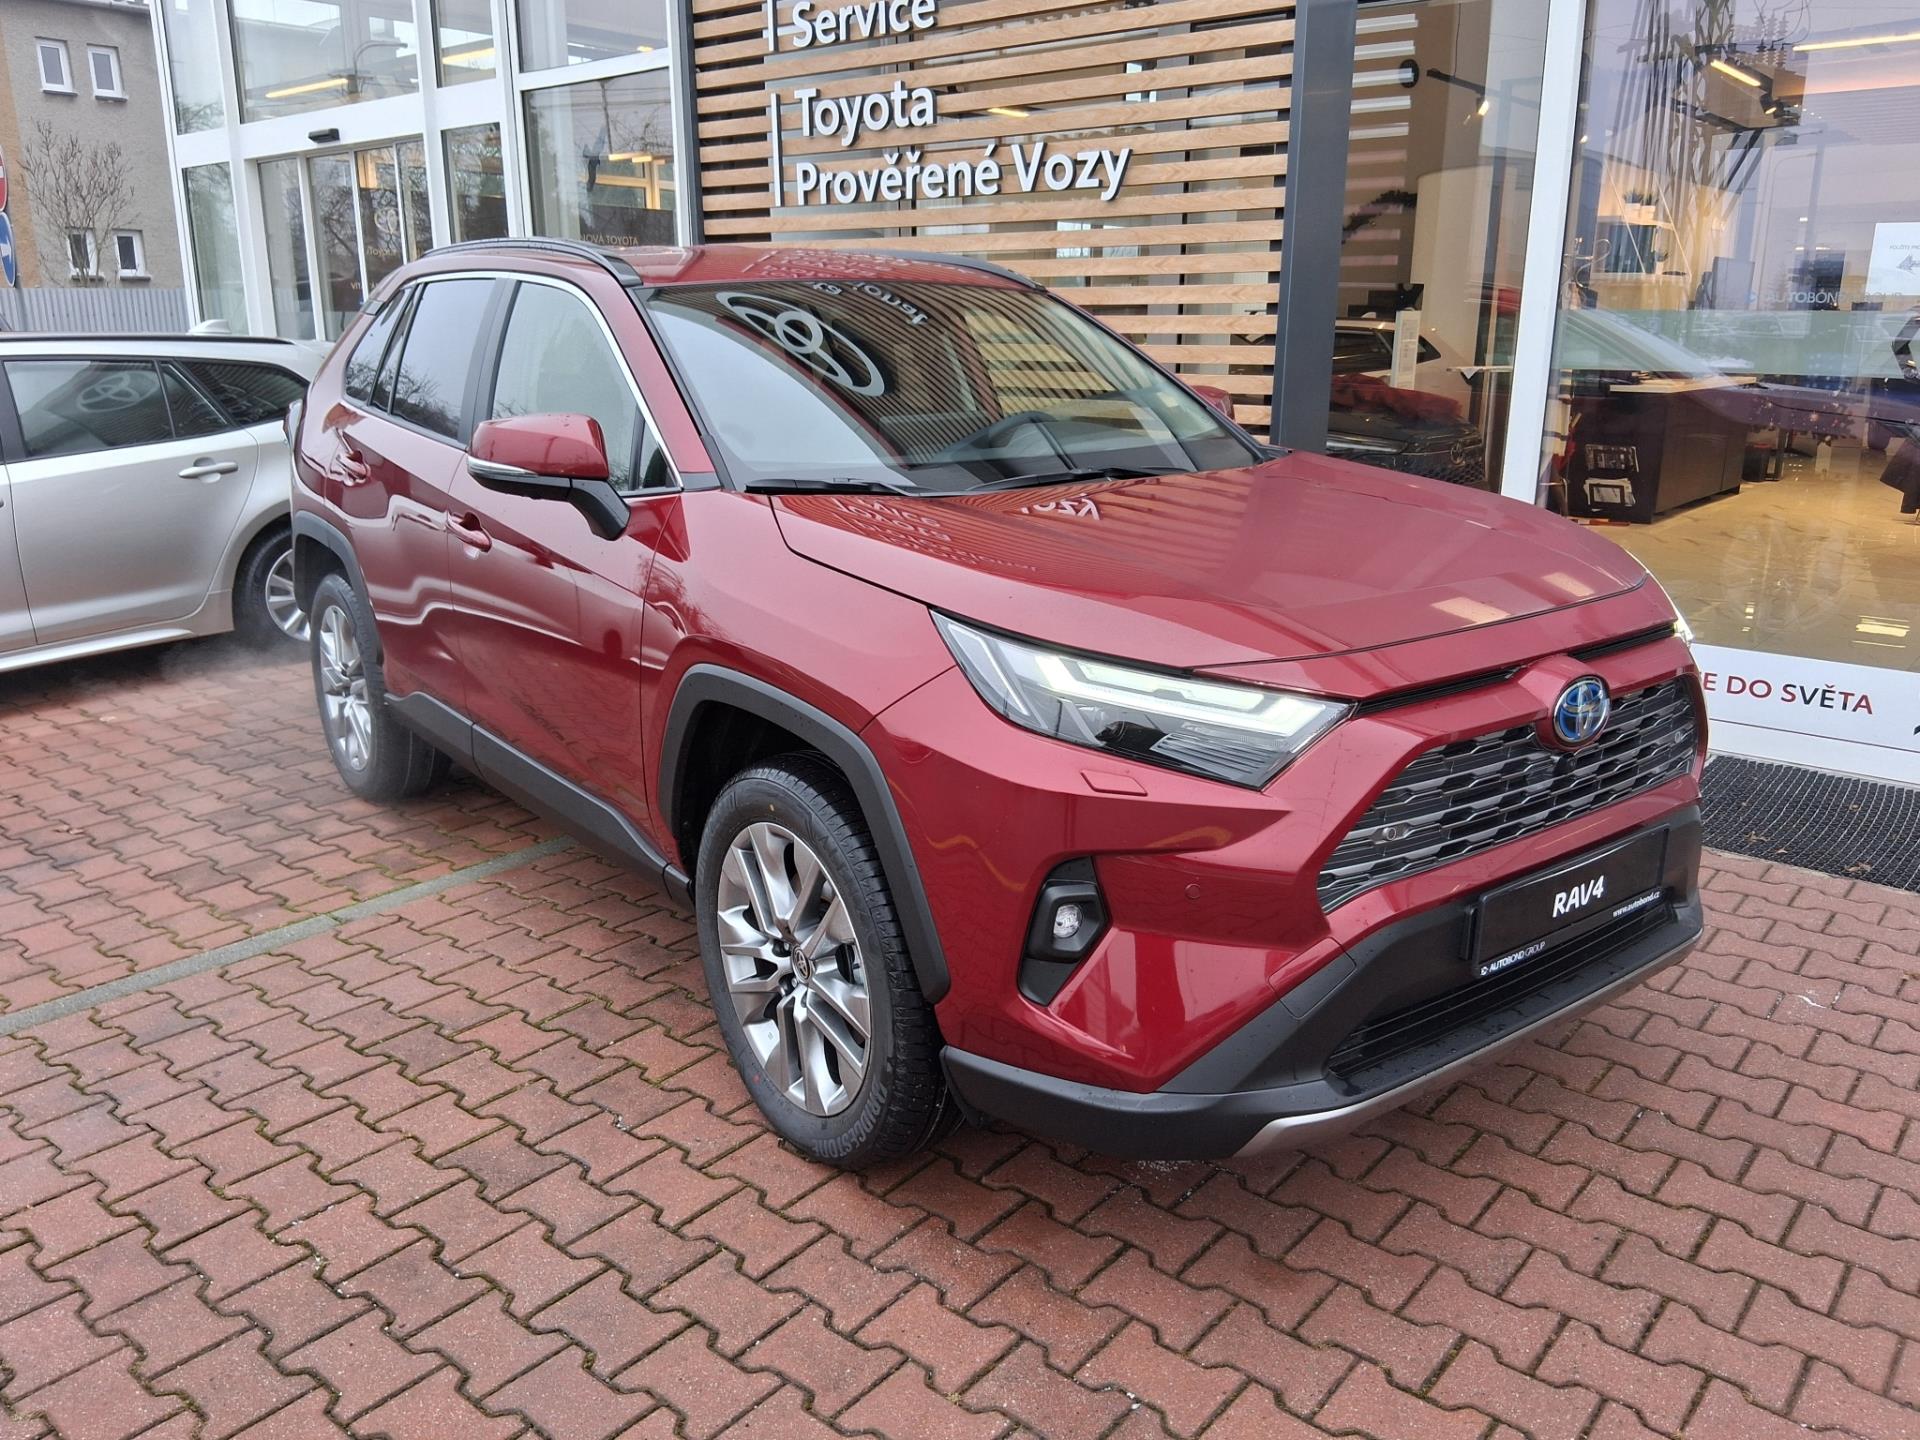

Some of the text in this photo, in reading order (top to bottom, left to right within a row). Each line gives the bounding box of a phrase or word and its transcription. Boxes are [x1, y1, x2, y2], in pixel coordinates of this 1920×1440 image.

[792, 0, 936, 48] Service
[794, 80, 937, 147] Toyota
[796, 141, 1133, 205] Prověřené Vozy
[1726, 675, 1773, 699] DO
[1780, 683, 1873, 715] SVĚTA
[1552, 875, 1605, 918] RAV4
[1489, 950, 1525, 973] AUTOBOND
